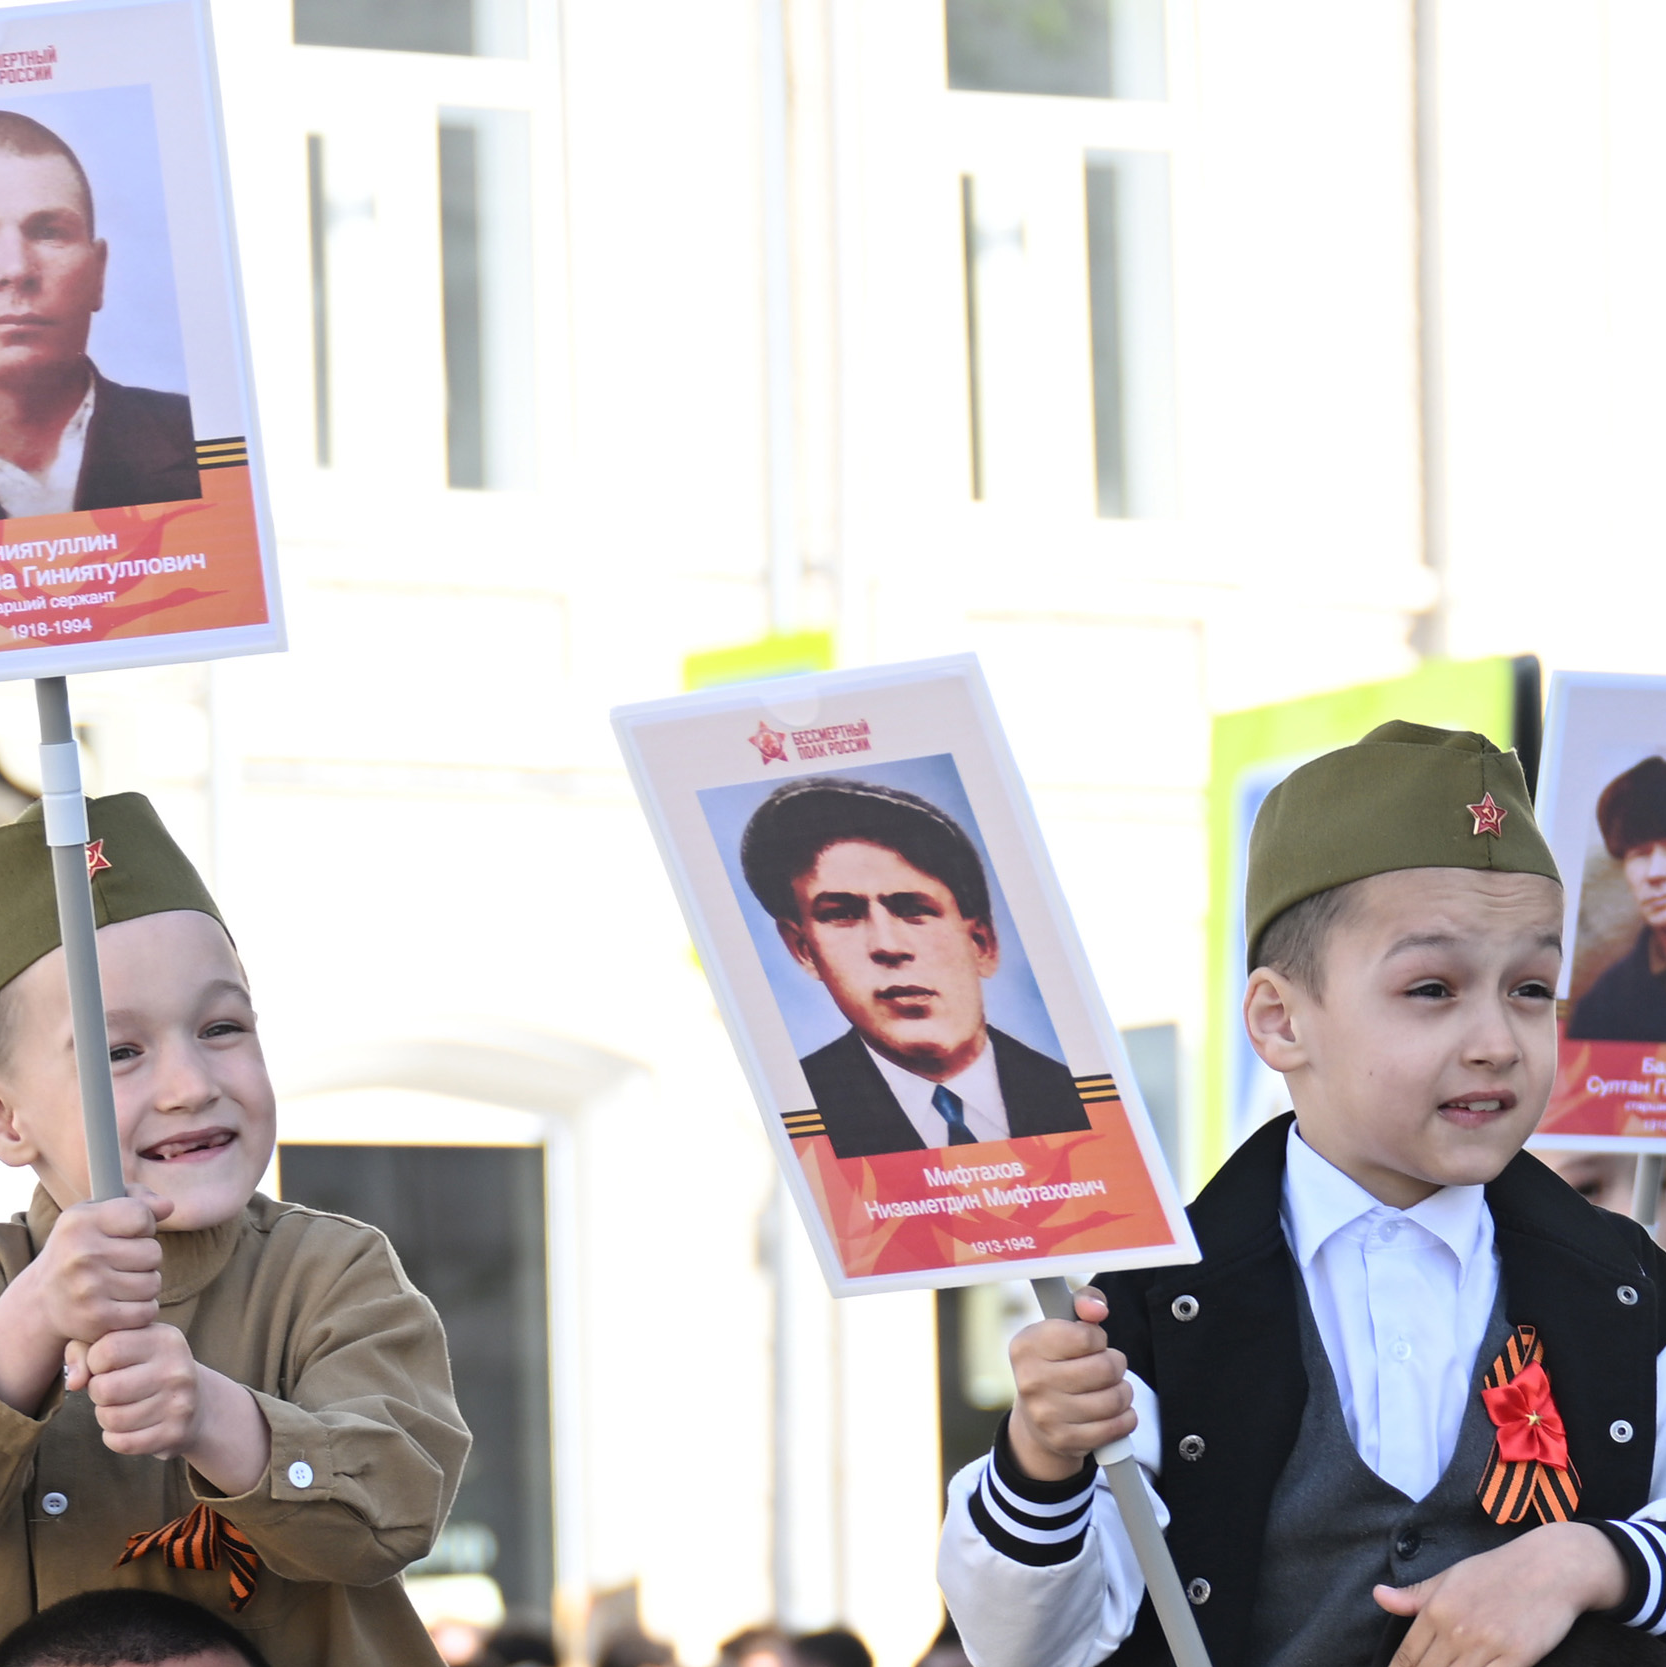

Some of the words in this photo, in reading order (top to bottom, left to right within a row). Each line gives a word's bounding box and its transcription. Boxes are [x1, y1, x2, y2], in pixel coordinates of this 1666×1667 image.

[0, 65, 53, 85] РОССИИ
[22, 553, 207, 587] Гиниятуллович
[50, 590, 116, 610] сержант
[9, 617, 93, 640] 1918-1994
[791, 718, 871, 745] БЕССМЕРТНЫЙ
[797, 743, 828, 760] ПОЛК
[828, 737, 871, 755] РОССИИ
[1586, 1075, 1650, 1097] Султан
[923, 1161, 1025, 1188] Мифтахов
[864, 1194, 981, 1221] Низаметдин
[982, 1179, 1107, 1208] Мифтахович
[970, 1236, 1036, 1254] 1913-1942
